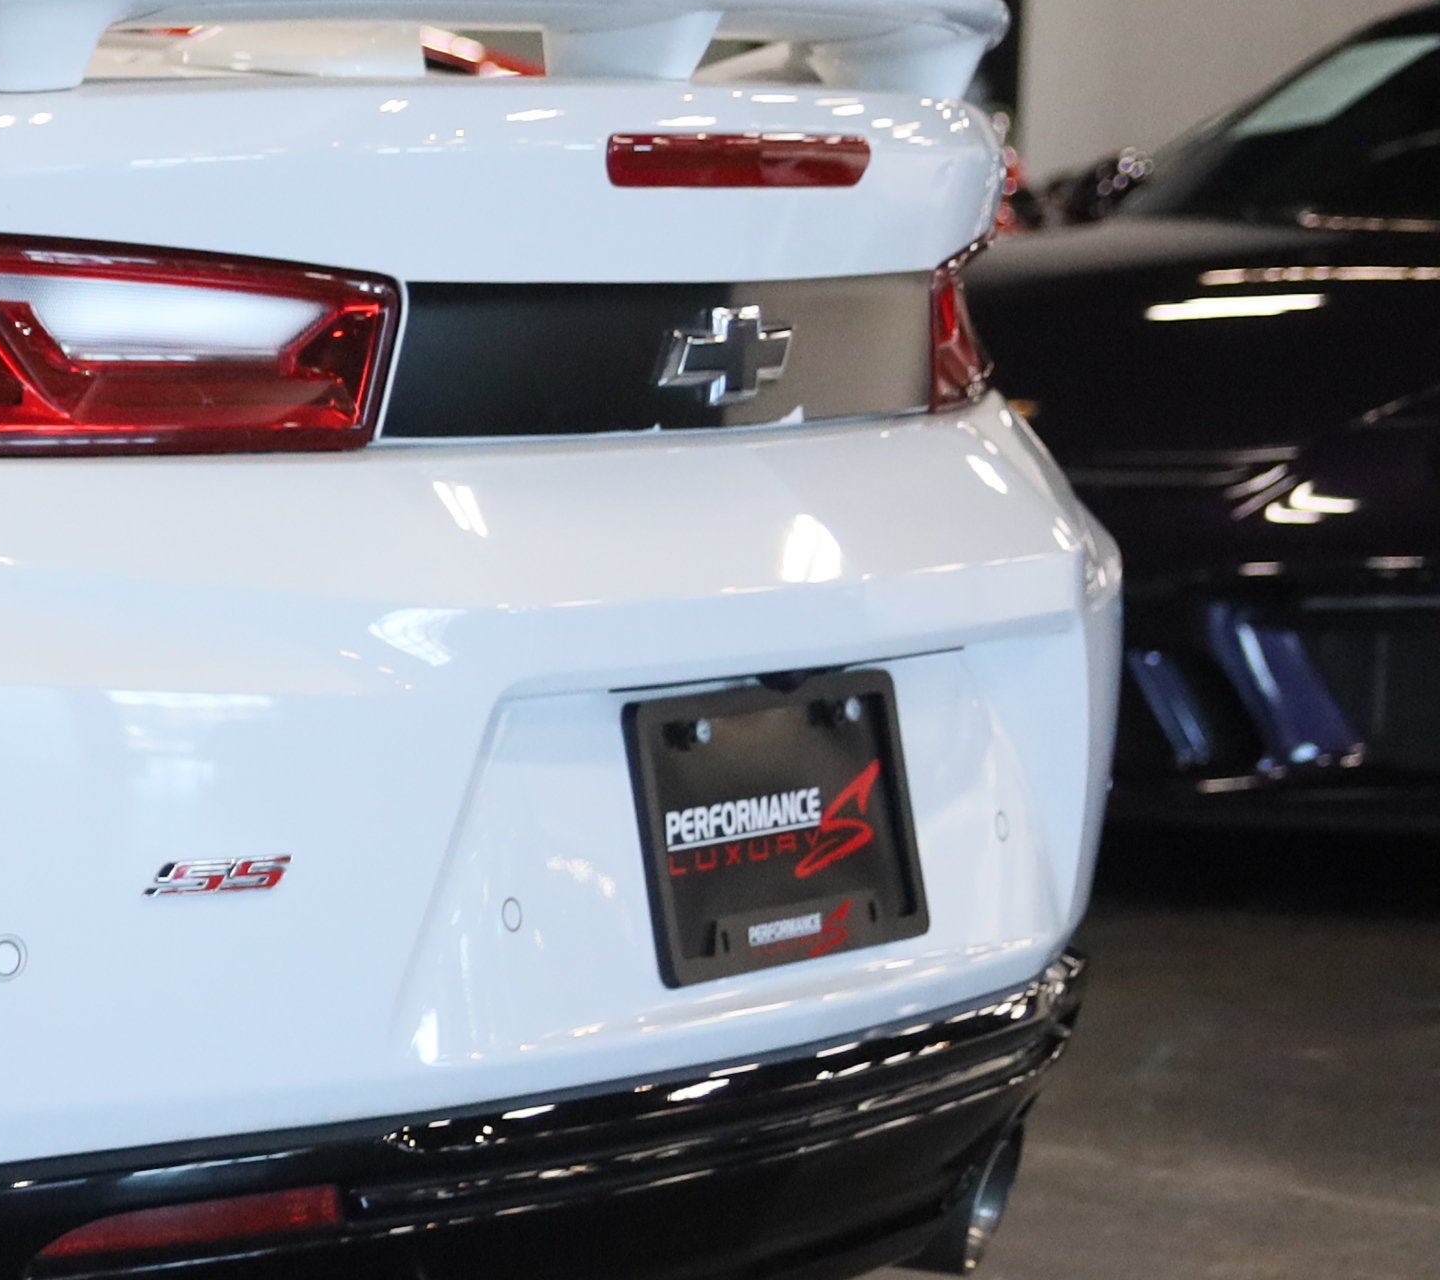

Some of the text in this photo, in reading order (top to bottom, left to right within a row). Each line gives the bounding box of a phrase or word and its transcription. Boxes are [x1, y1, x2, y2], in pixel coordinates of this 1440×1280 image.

[665, 786, 821, 846] PERFORMANCE
[143, 854, 293, 897] SS
[668, 828, 820, 876] LUXURY
